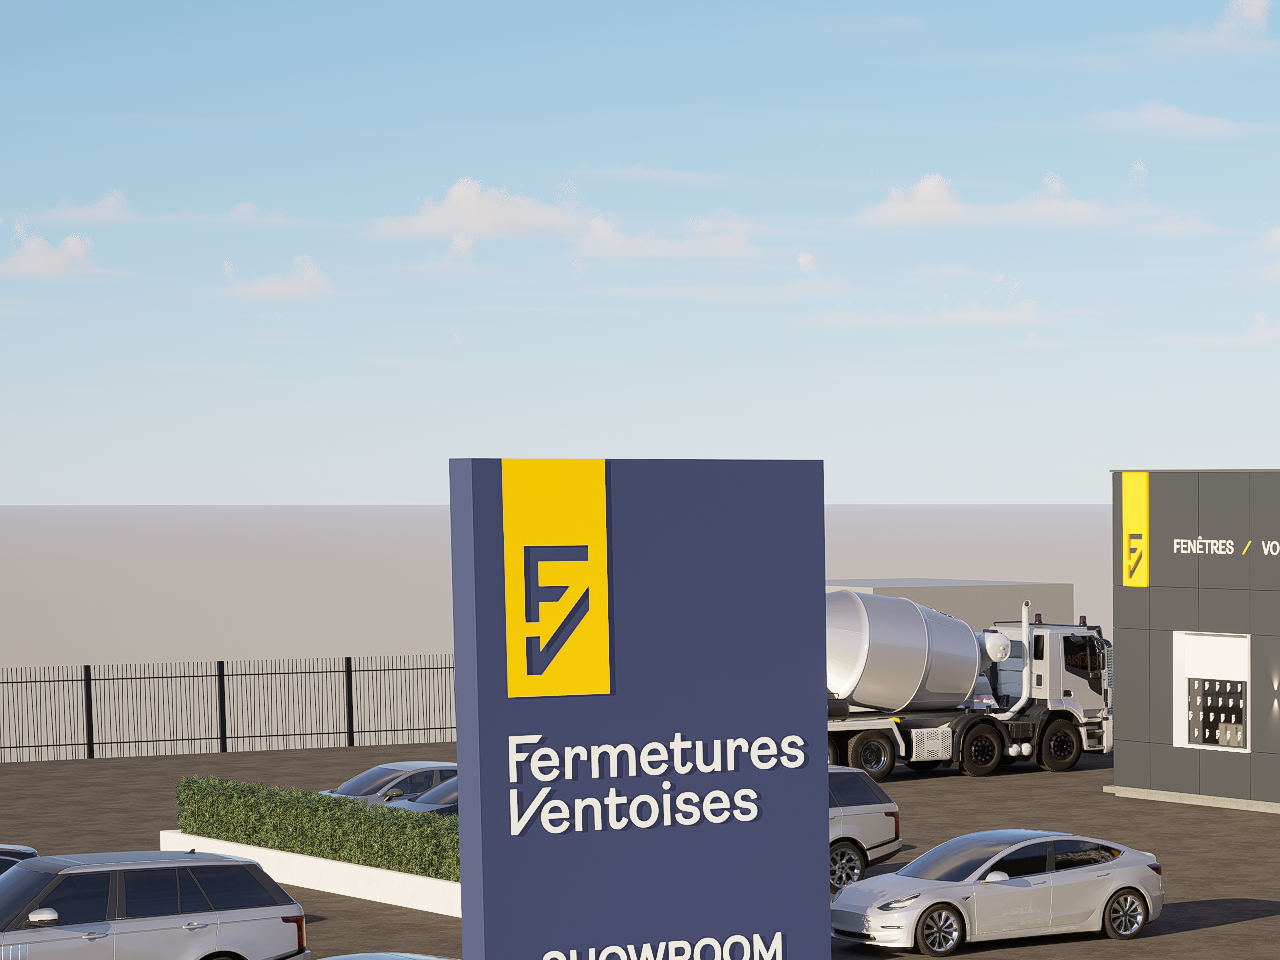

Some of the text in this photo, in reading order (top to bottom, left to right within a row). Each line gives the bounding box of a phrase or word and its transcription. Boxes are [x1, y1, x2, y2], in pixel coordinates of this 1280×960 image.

[1173, 535, 1235, 555] FENÊTRES
[508, 732, 805, 783] Fermetures
[509, 781, 758, 836] Ventoises
